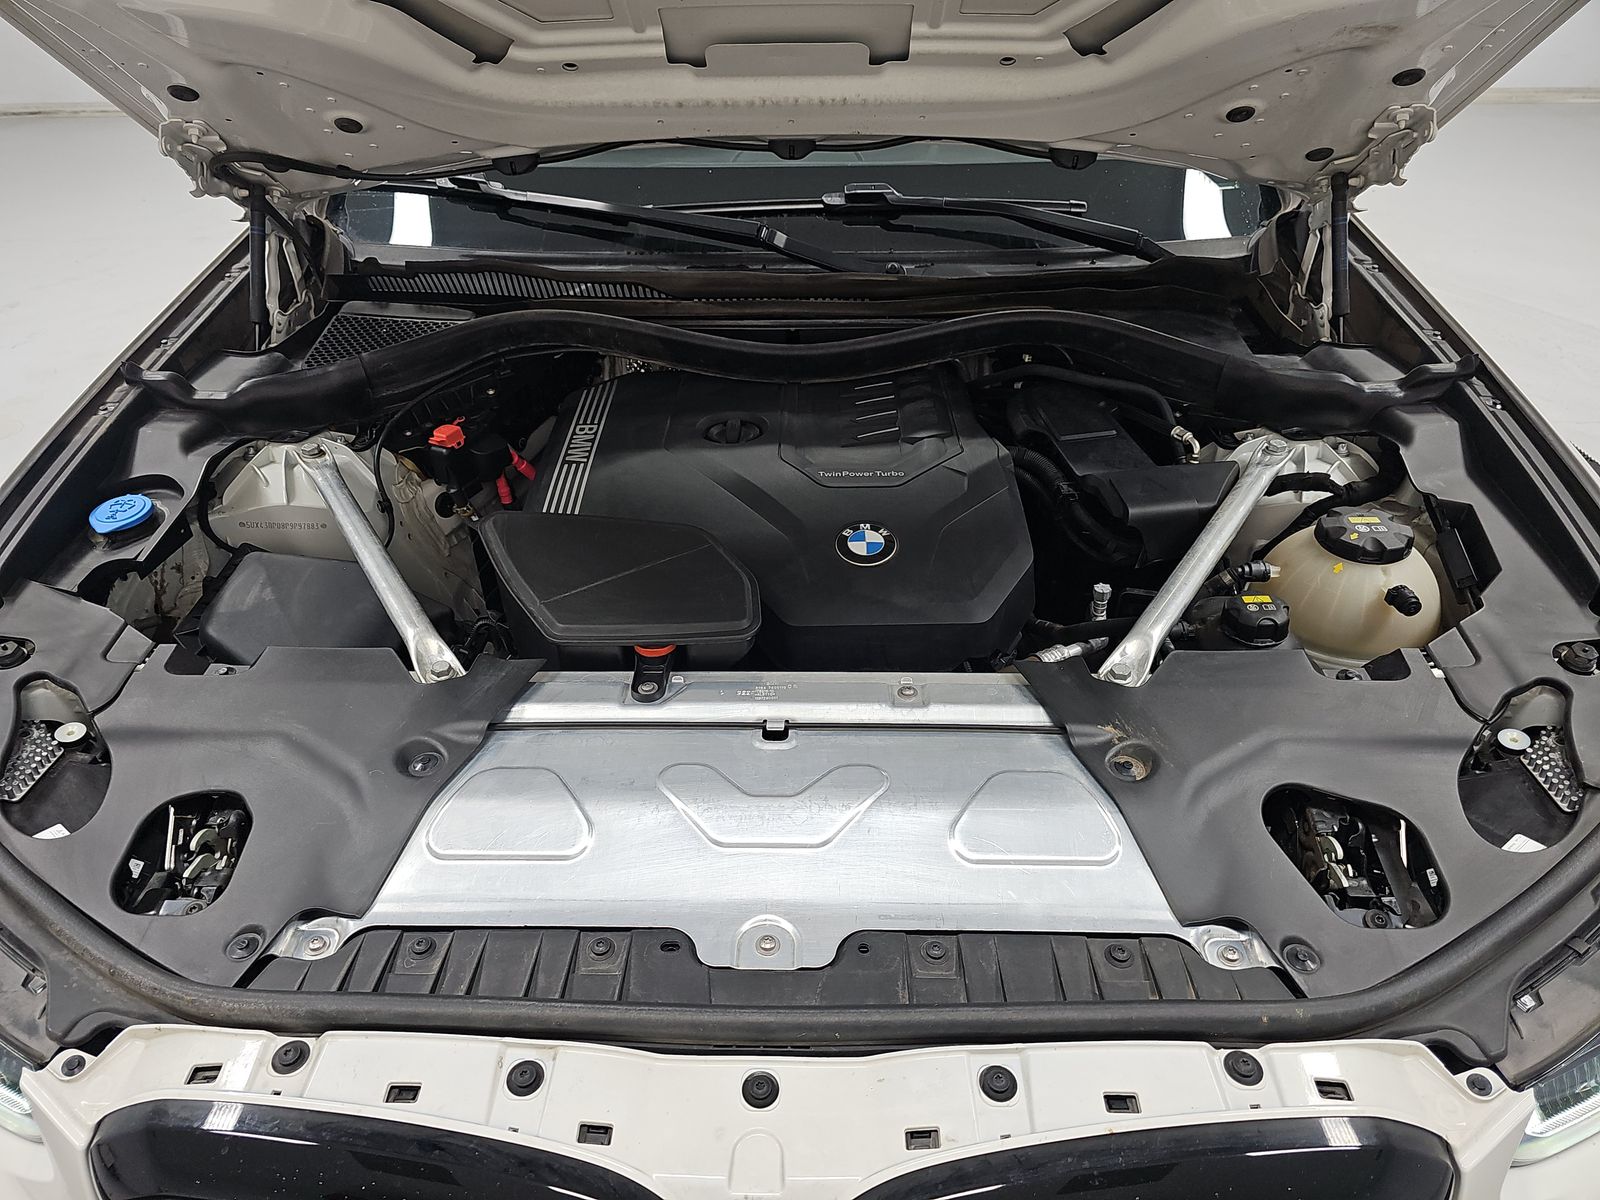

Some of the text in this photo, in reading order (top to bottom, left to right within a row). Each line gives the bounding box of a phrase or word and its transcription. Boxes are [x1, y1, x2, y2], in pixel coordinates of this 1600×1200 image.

[565, 424, 599, 463] BMW
[818, 470, 905, 478] TwinPower Turbo
[841, 523, 891, 537] BMW
